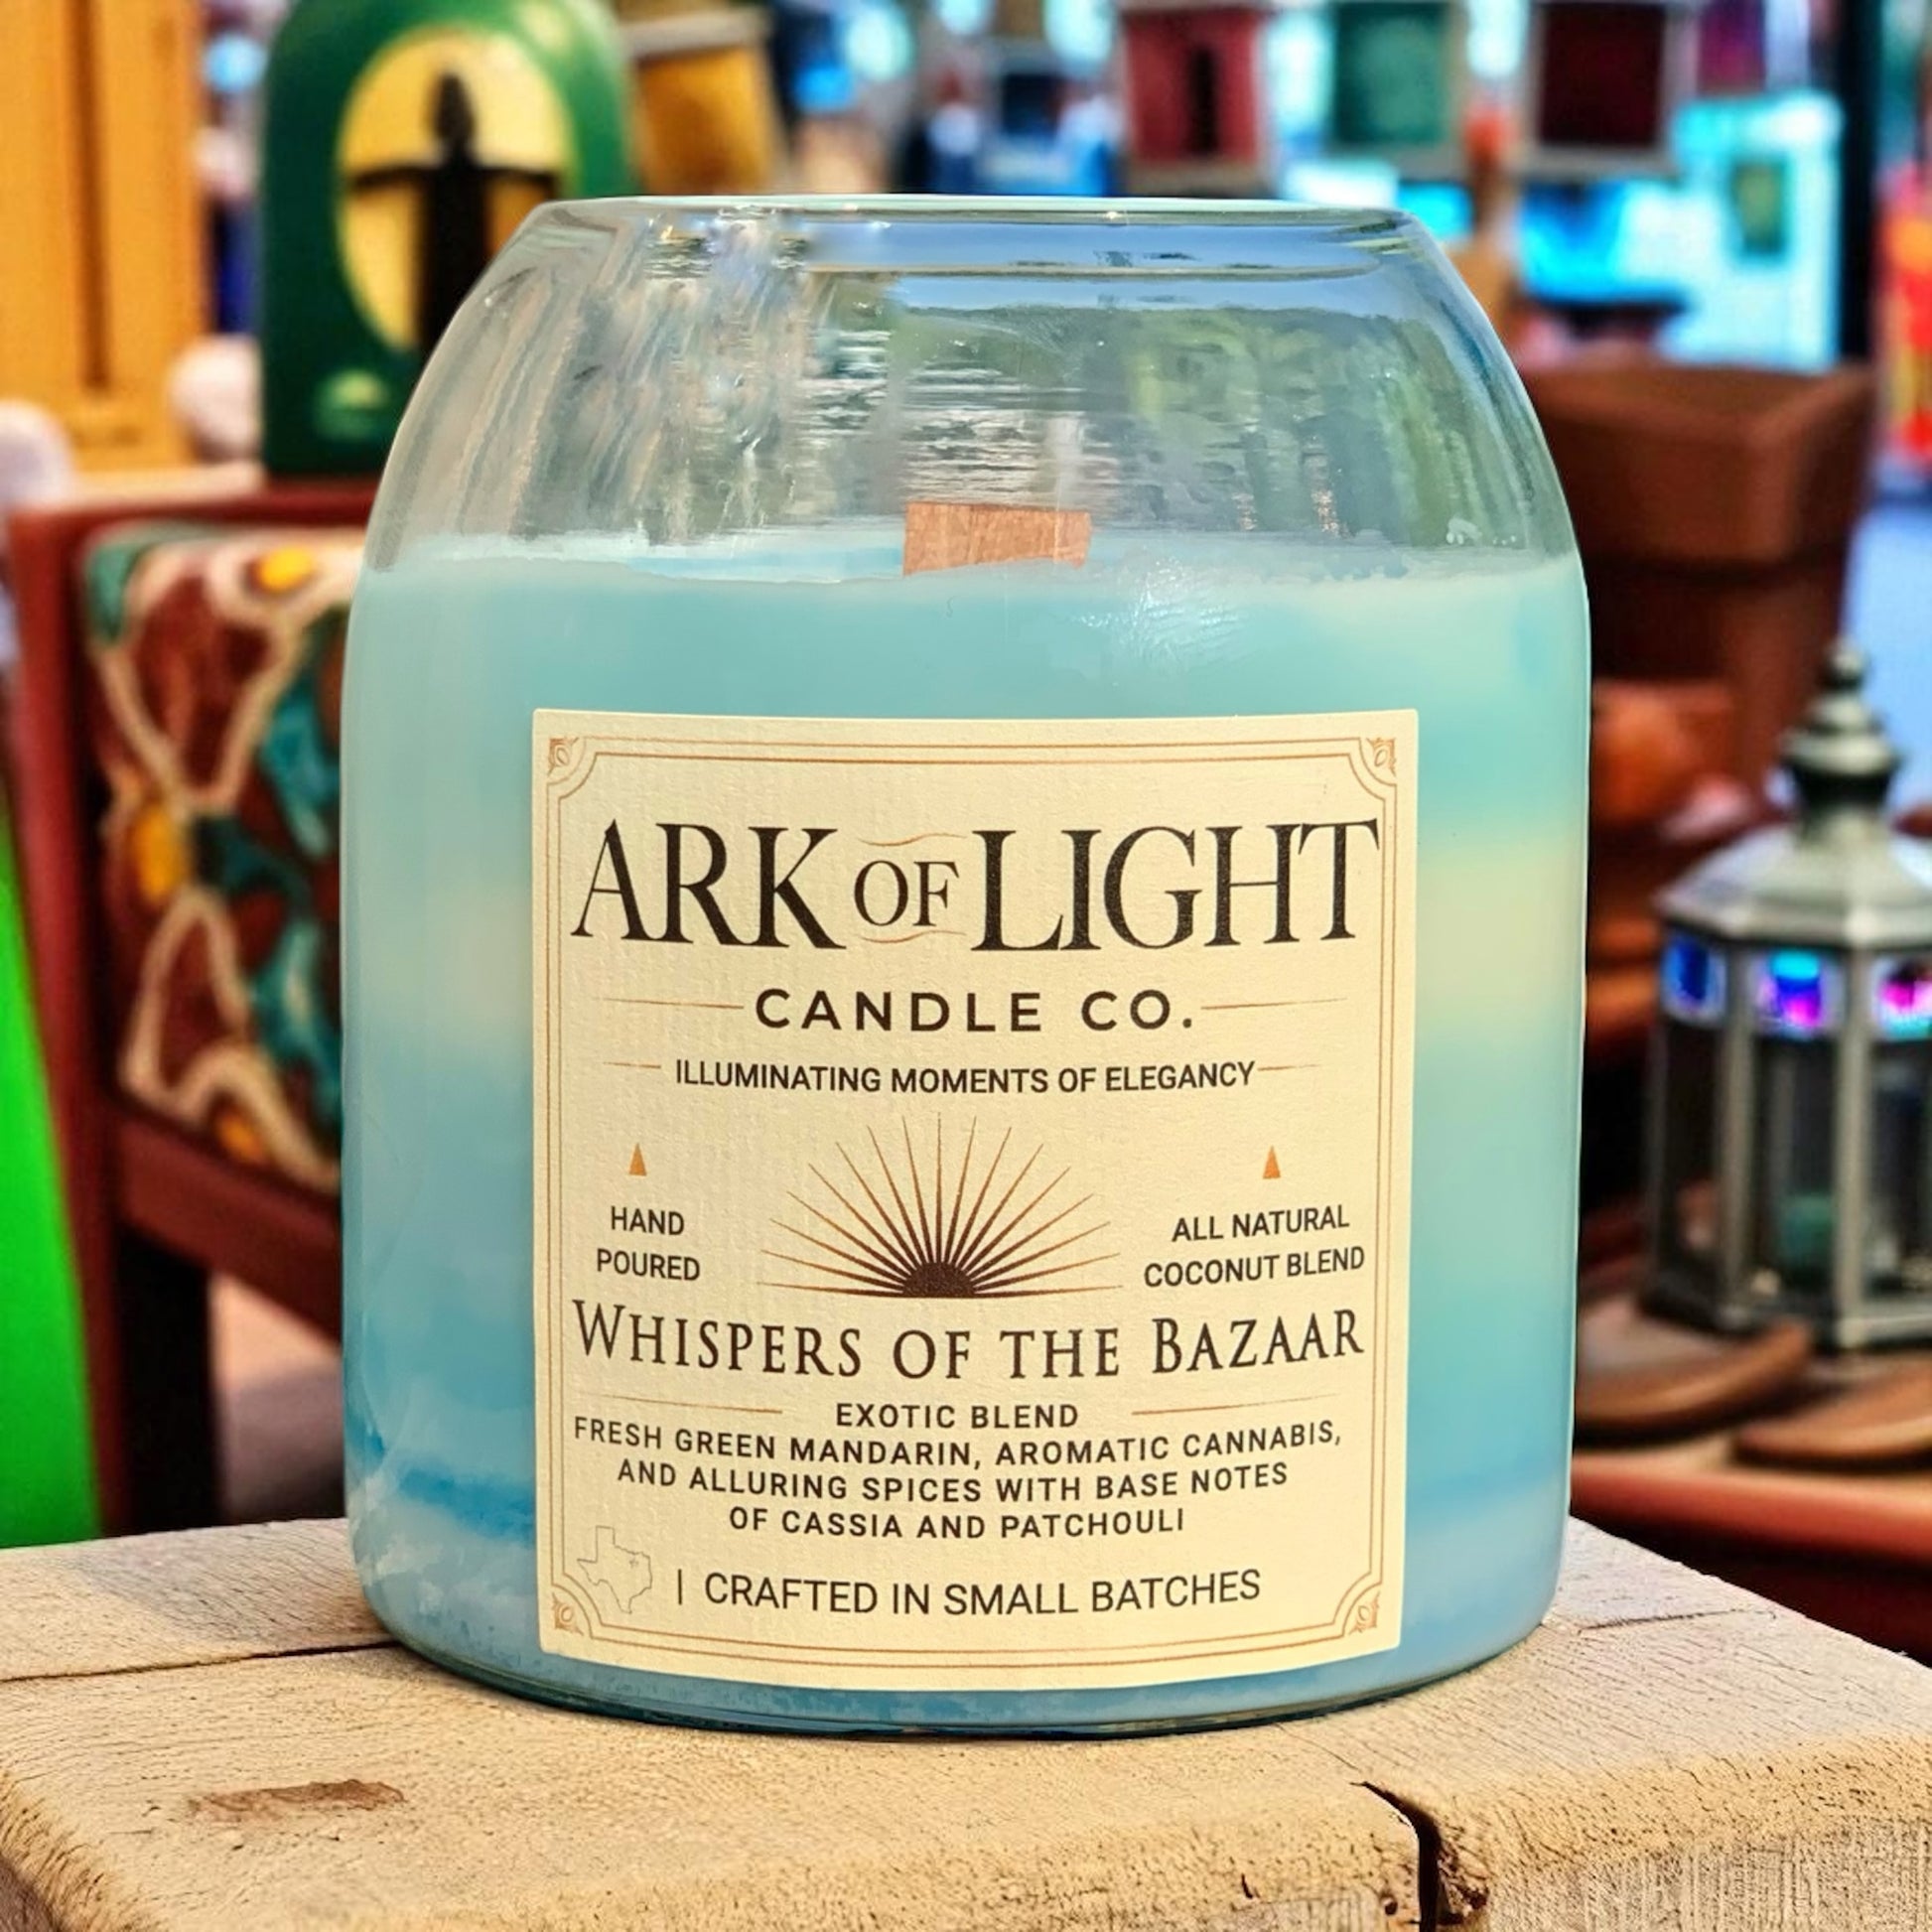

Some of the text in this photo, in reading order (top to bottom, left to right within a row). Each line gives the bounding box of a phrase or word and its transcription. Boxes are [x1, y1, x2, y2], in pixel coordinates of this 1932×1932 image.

[570, 818, 1379, 952] ARK OF LIGHT
[756, 988, 1192, 1033] CANDLE CO.
[676, 1058, 1255, 1094] ILLUMINATING MOMENTS OF ELEGANCY
[611, 1205, 685, 1236] HAND
[1172, 1204, 1350, 1243] ALL NATURAL
[597, 1247, 701, 1282] POURED
[1144, 1246, 1365, 1288] COCONUT BLEND
[893, 1329, 971, 1379] OF
[999, 1327, 1119, 1379] THE
[836, 1403, 1078, 1430] EXOTIC BLEND
[575, 1416, 1340, 1470] FRESH GREEN MANDARIN, AROMATIC CANNABIS,
[618, 1458, 1287, 1503] AND ALLURING SPICES WITH BASE NOTES
[729, 1506, 1183, 1539] OF CASSIA AND PATCHOULI
[705, 1569, 1260, 1615] CRAFTED IN SMALL BATCHES
